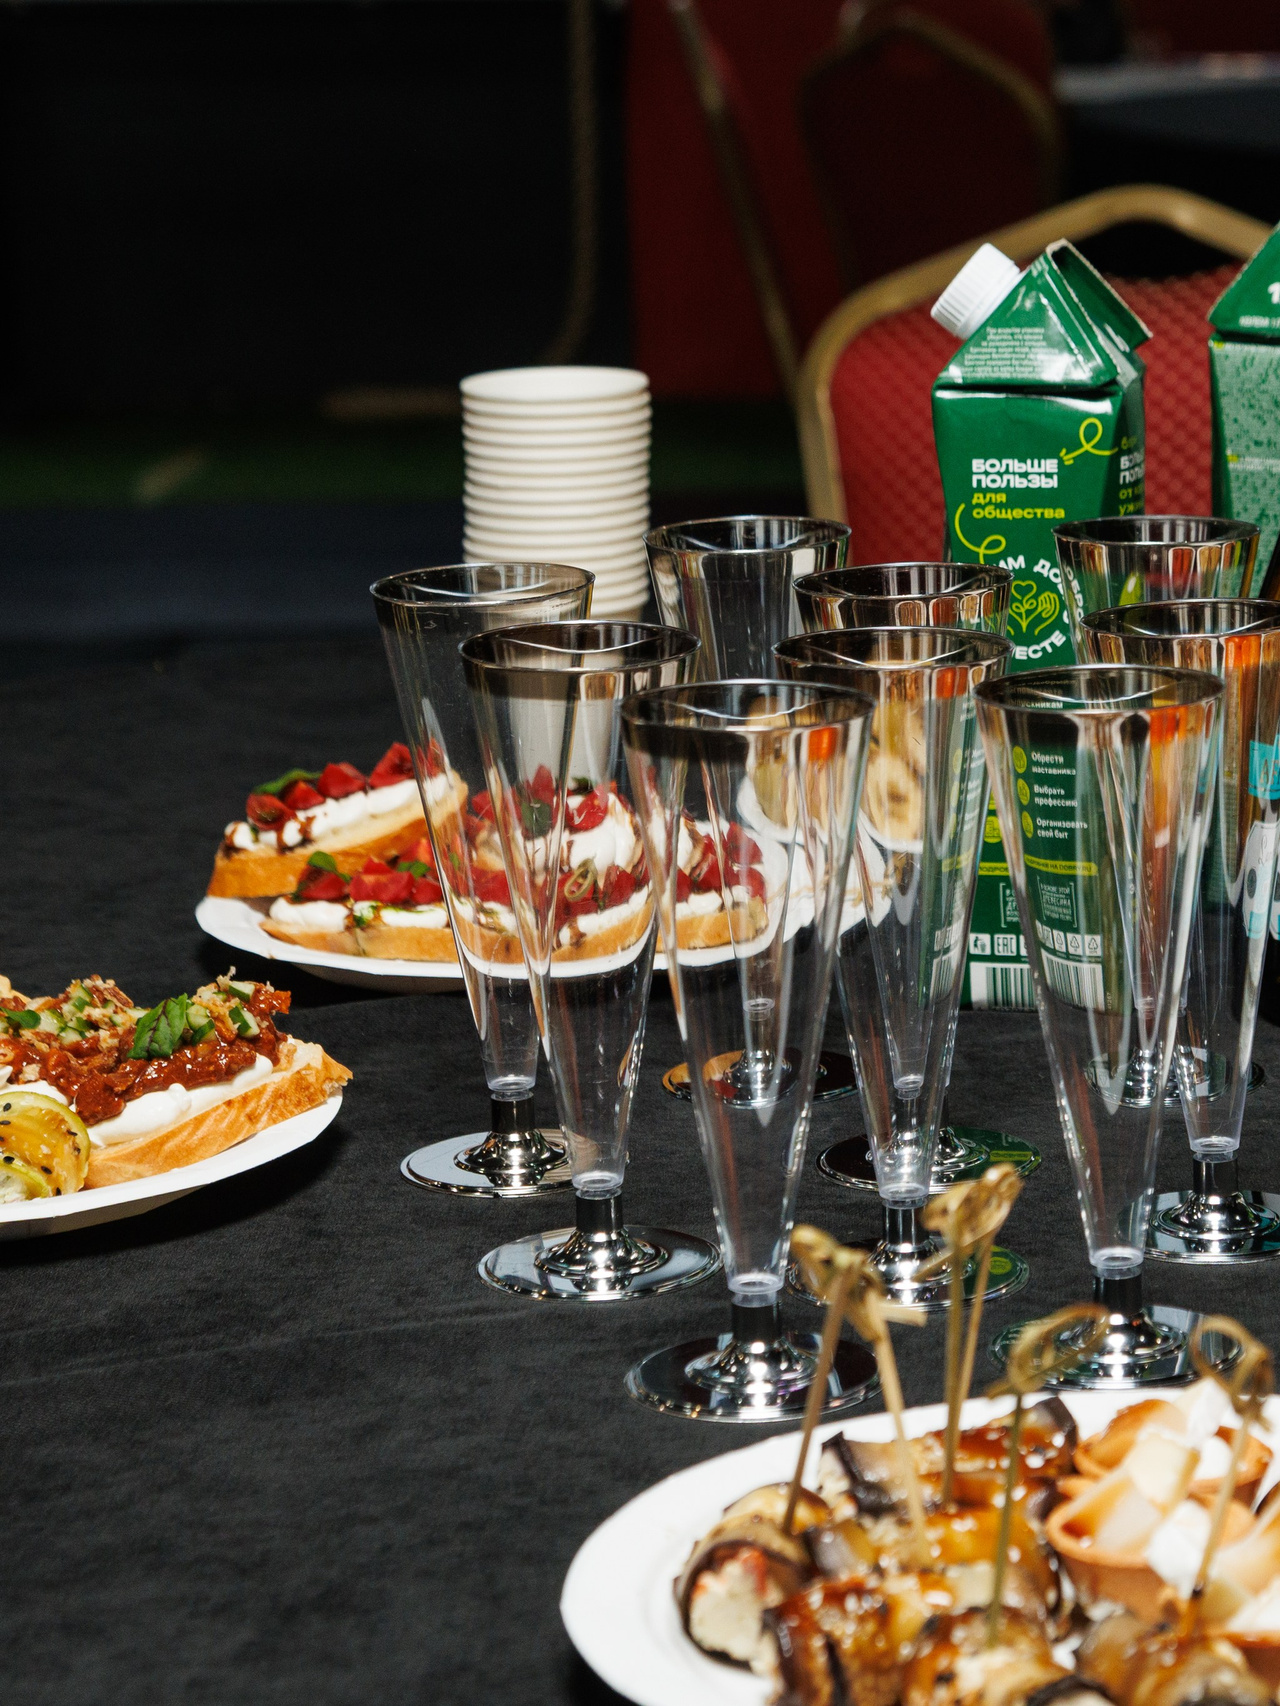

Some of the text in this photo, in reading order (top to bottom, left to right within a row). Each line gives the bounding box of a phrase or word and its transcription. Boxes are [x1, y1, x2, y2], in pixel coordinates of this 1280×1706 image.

[972, 459, 1058, 473] БОЛЬШЕ
[972, 474, 1058, 488] ПОЛЬЗЫ
[972, 492, 1006, 505] для
[972, 507, 1065, 520] общества
[1031, 751, 1065, 765] Обрести
[1033, 784, 1066, 796] Выбрать
[1034, 797, 1078, 808] профессию
[1036, 817, 1089, 830] Организовать
